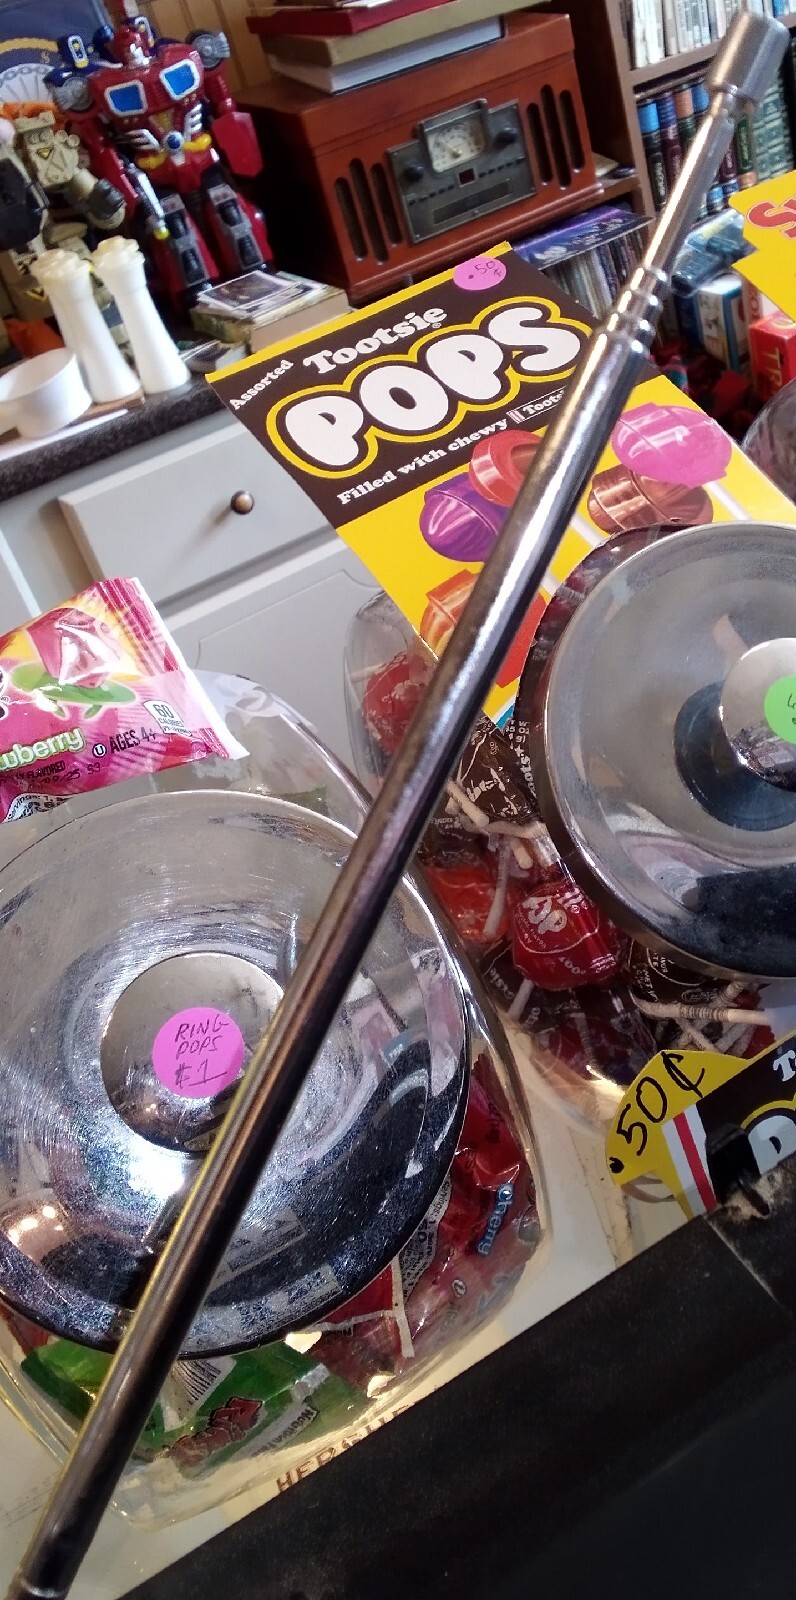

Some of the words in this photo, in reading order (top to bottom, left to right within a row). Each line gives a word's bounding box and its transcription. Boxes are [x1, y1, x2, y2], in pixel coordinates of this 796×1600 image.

[302, 307, 448, 375] Tootsie
[229, 359, 295, 411] Assorted
[284, 306, 582, 467] POPS
[336, 469, 398, 505] Filled
[398, 447, 448, 476] with
[447, 415, 510, 451] chewy
[109, 729, 141, 754] AGES
[174, 1014, 230, 1042] RING
[175, 1034, 224, 1060] POPS
